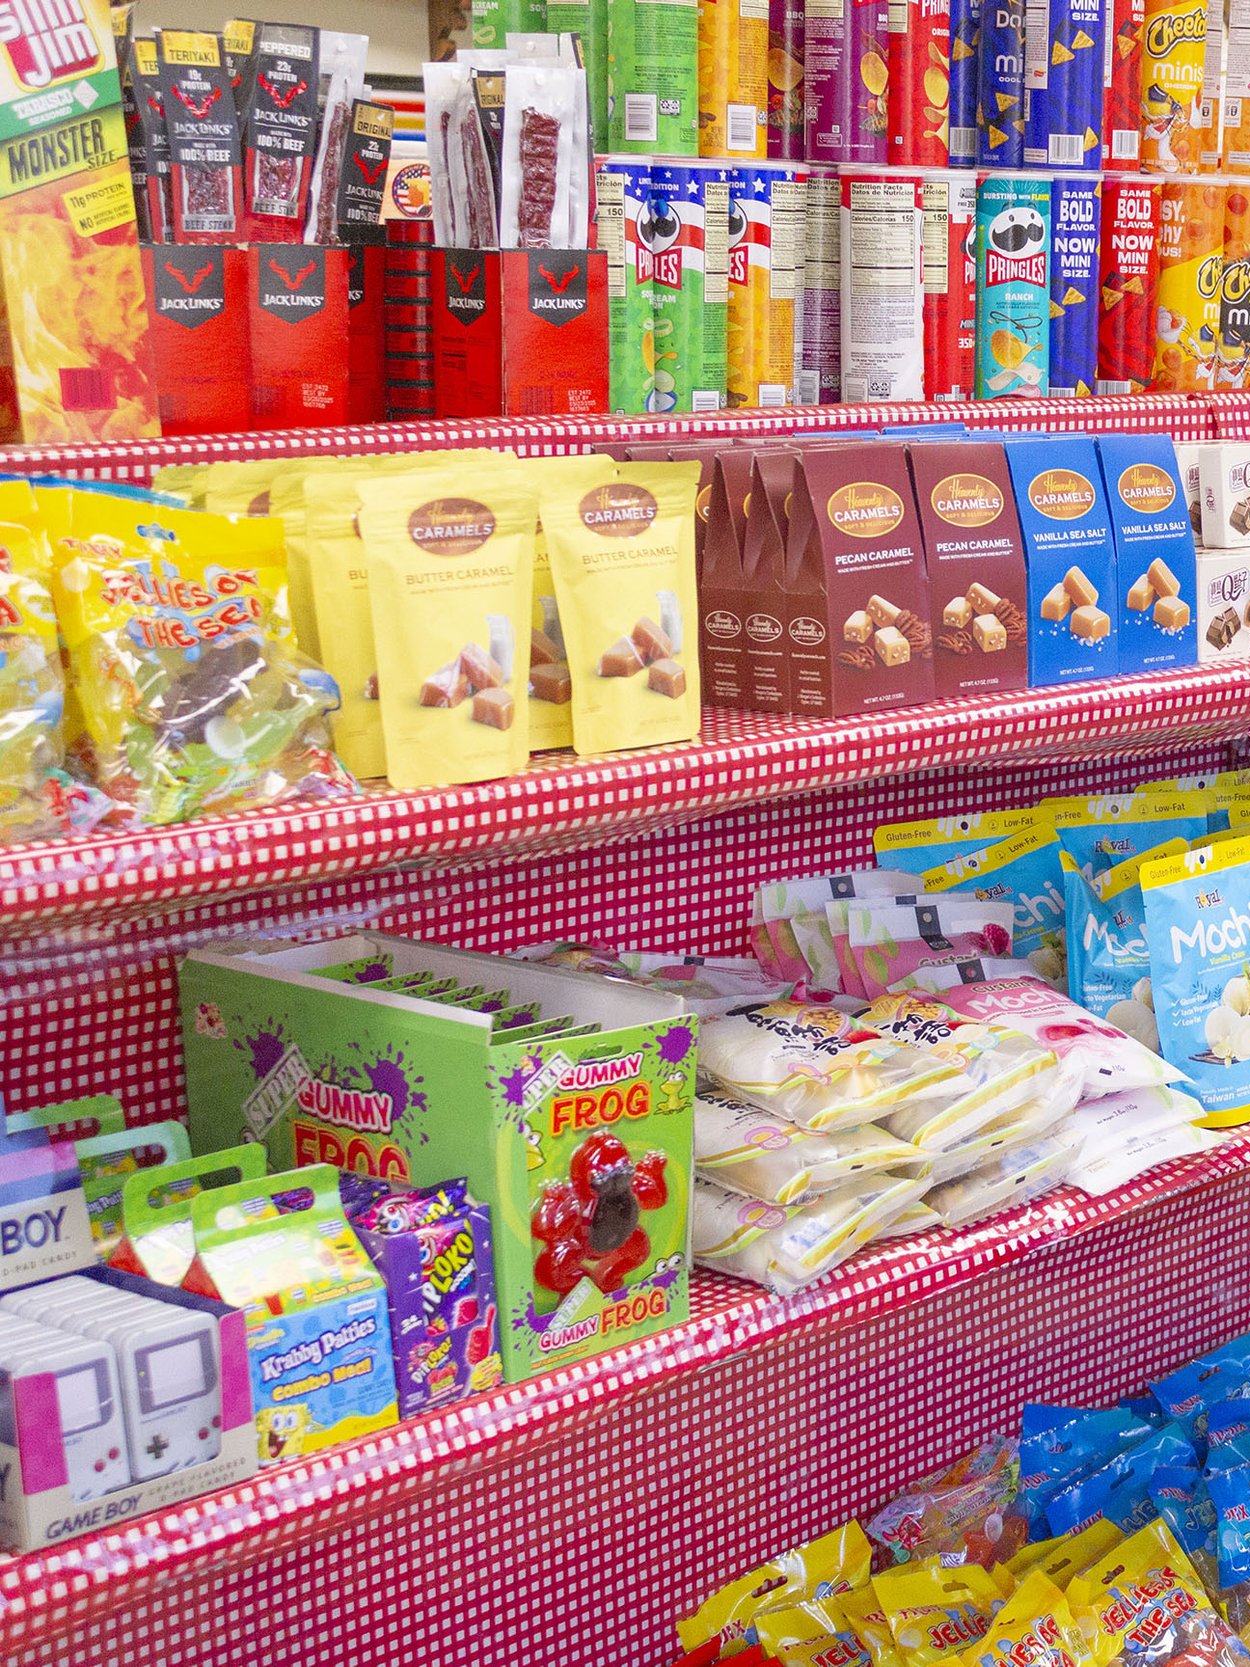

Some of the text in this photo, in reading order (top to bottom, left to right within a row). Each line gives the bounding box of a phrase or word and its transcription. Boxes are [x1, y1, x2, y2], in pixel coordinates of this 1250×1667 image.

[1072, 13, 1100, 21] SIZE.
[169, 50, 215, 63] TERIYAKI
[267, 70, 298, 82] PROTEIN
[1153, 61, 1204, 82] minis
[181, 80, 211, 91] PROTEIN
[254, 109, 279, 124] JACK
[7, 118, 106, 184] MONSTER
[257, 135, 305, 151] 100% BEEF
[87, 150, 117, 171] SIZE
[181, 148, 231, 162] 100% BEEF
[86, 183, 125, 203] PROTEIN
[607, 208, 623, 216] 150
[933, 214, 947, 222] 150
[1060, 201, 1093, 222] BOLD
[1117, 199, 1151, 220] BOLD
[1055, 238, 1095, 253] NOW
[1112, 236, 1153, 250] NOW
[1061, 255, 1091, 267] MINI
[1118, 252, 1148, 264] MINI
[988, 253, 1045, 284] PRINGLES
[1120, 266, 1148, 274] SIZE.
[160, 298, 188, 310] JACK
[262, 294, 290, 307] JACK
[584, 507, 654, 524] CARAMELS
[834, 505, 899, 523] CARAMELS
[412, 524, 492, 540] CARAMELS
[1033, 528, 1107, 543] VANILLA SEA SALT
[1122, 521, 1187, 535] VANILLA SEA SALT
[936, 539, 1013, 552] PECAN CARAMEL
[582, 546, 678, 566] BUTTER CARAMEL
[835, 547, 914, 566] PECAN CARAMEL
[406, 566, 514, 585] BUTTER CARAMEL
[139, 615, 198, 649] THE
[1154, 802, 1185, 812] Low-Fat
[886, 816, 1033, 842] Gluten-Free Low-Fat
[1008, 835, 1038, 853] Low-Fat
[559, 1052, 644, 1091] GUMMY
[297, 1077, 394, 1134] GUMMY
[1201, 1091, 1235, 1104] Taiwan
[551, 1080, 651, 1137] FROG
[1, 1206, 68, 1255] BOY
[42, 1251, 78, 1266] CANDY
[538, 1289, 666, 1352] GUMMY FROG
[260, 1317, 376, 1382] Krabby Patties
[272, 1356, 373, 1402] Combo Meal
[47, 1496, 143, 1539] GAME BOY
[1128, 1607, 1173, 1648] THE
